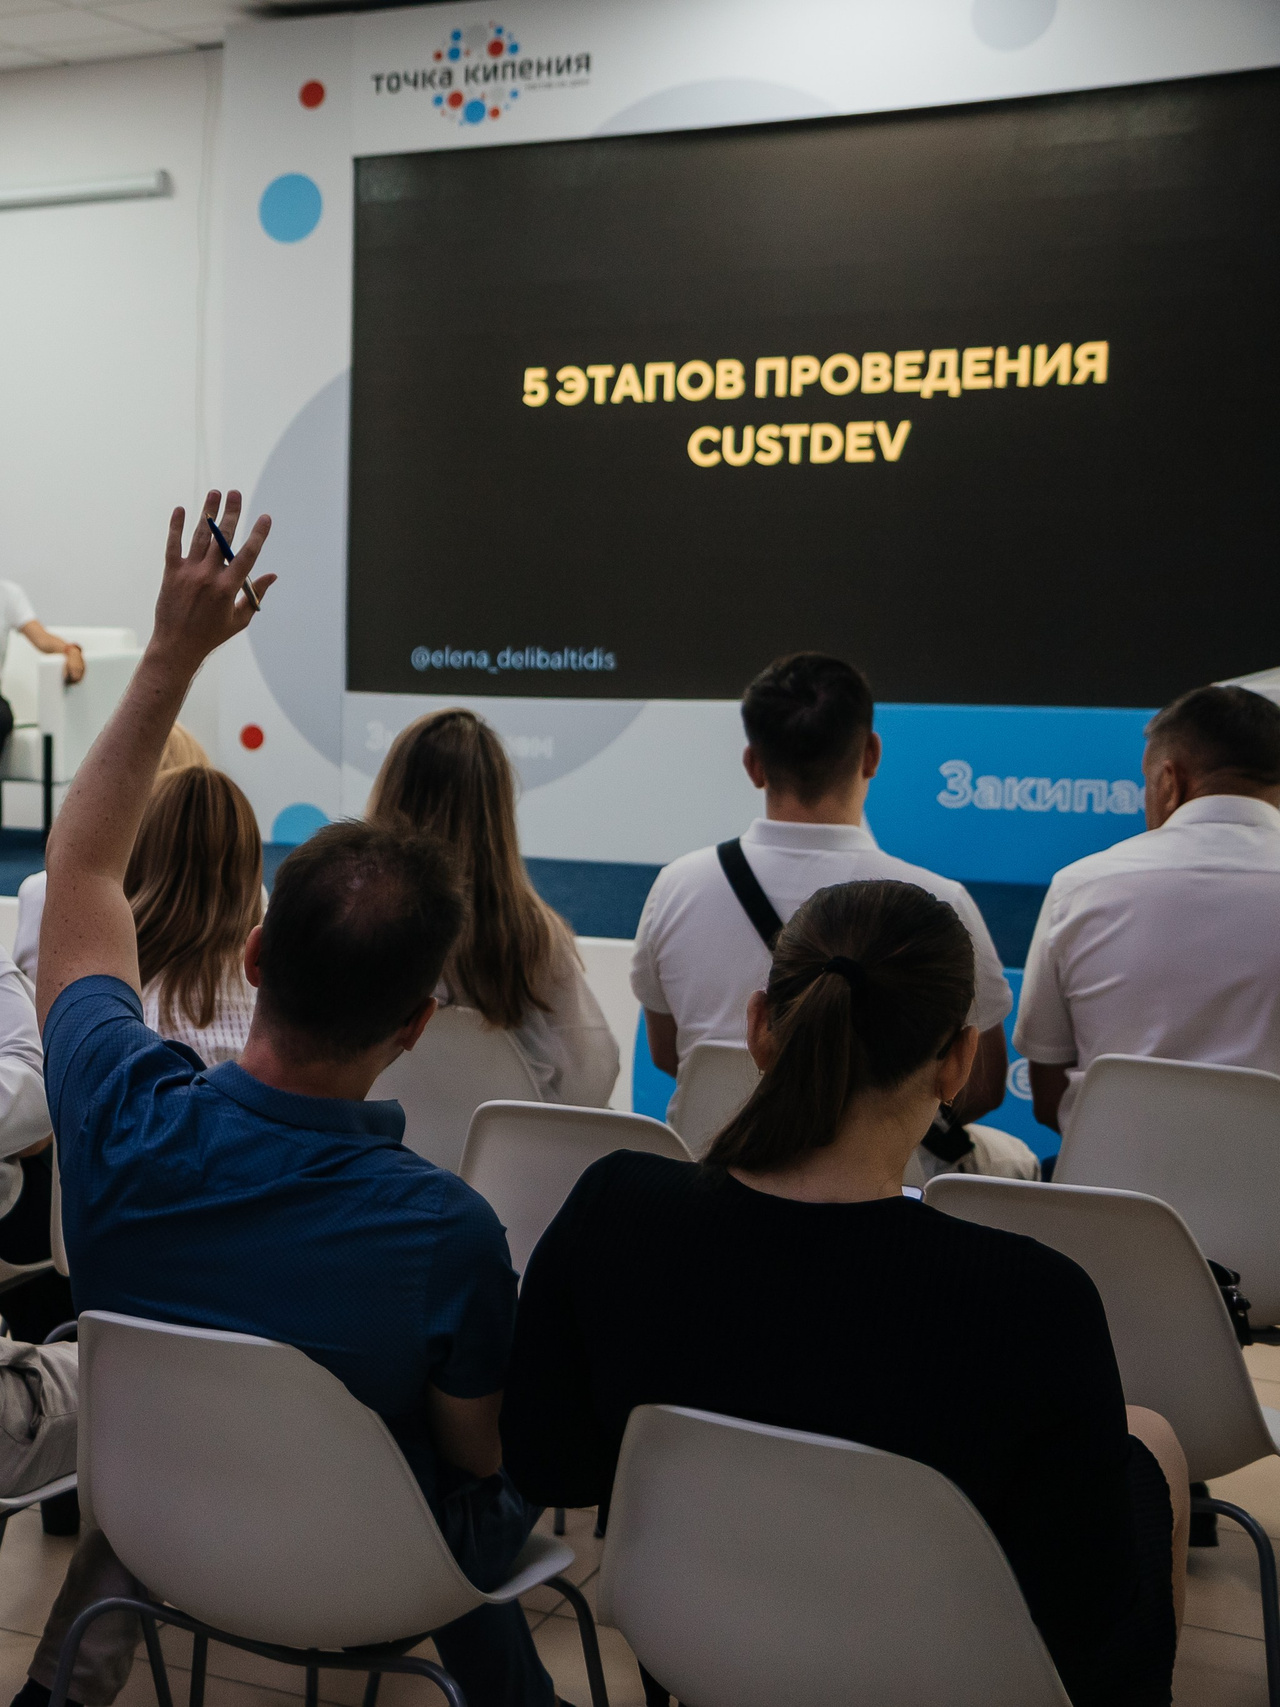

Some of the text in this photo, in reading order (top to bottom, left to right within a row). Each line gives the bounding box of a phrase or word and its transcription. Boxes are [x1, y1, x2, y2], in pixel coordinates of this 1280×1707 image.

[372, 52, 591, 95] точка кипения
[522, 341, 1110, 407] 5 ЭТАПОВ ПРОВЕДЕНИЯ
[686, 420, 911, 467] CUSTDEV
[410, 645, 616, 675] @elena_delibaltidis
[936, 759, 1146, 814] Закипа
